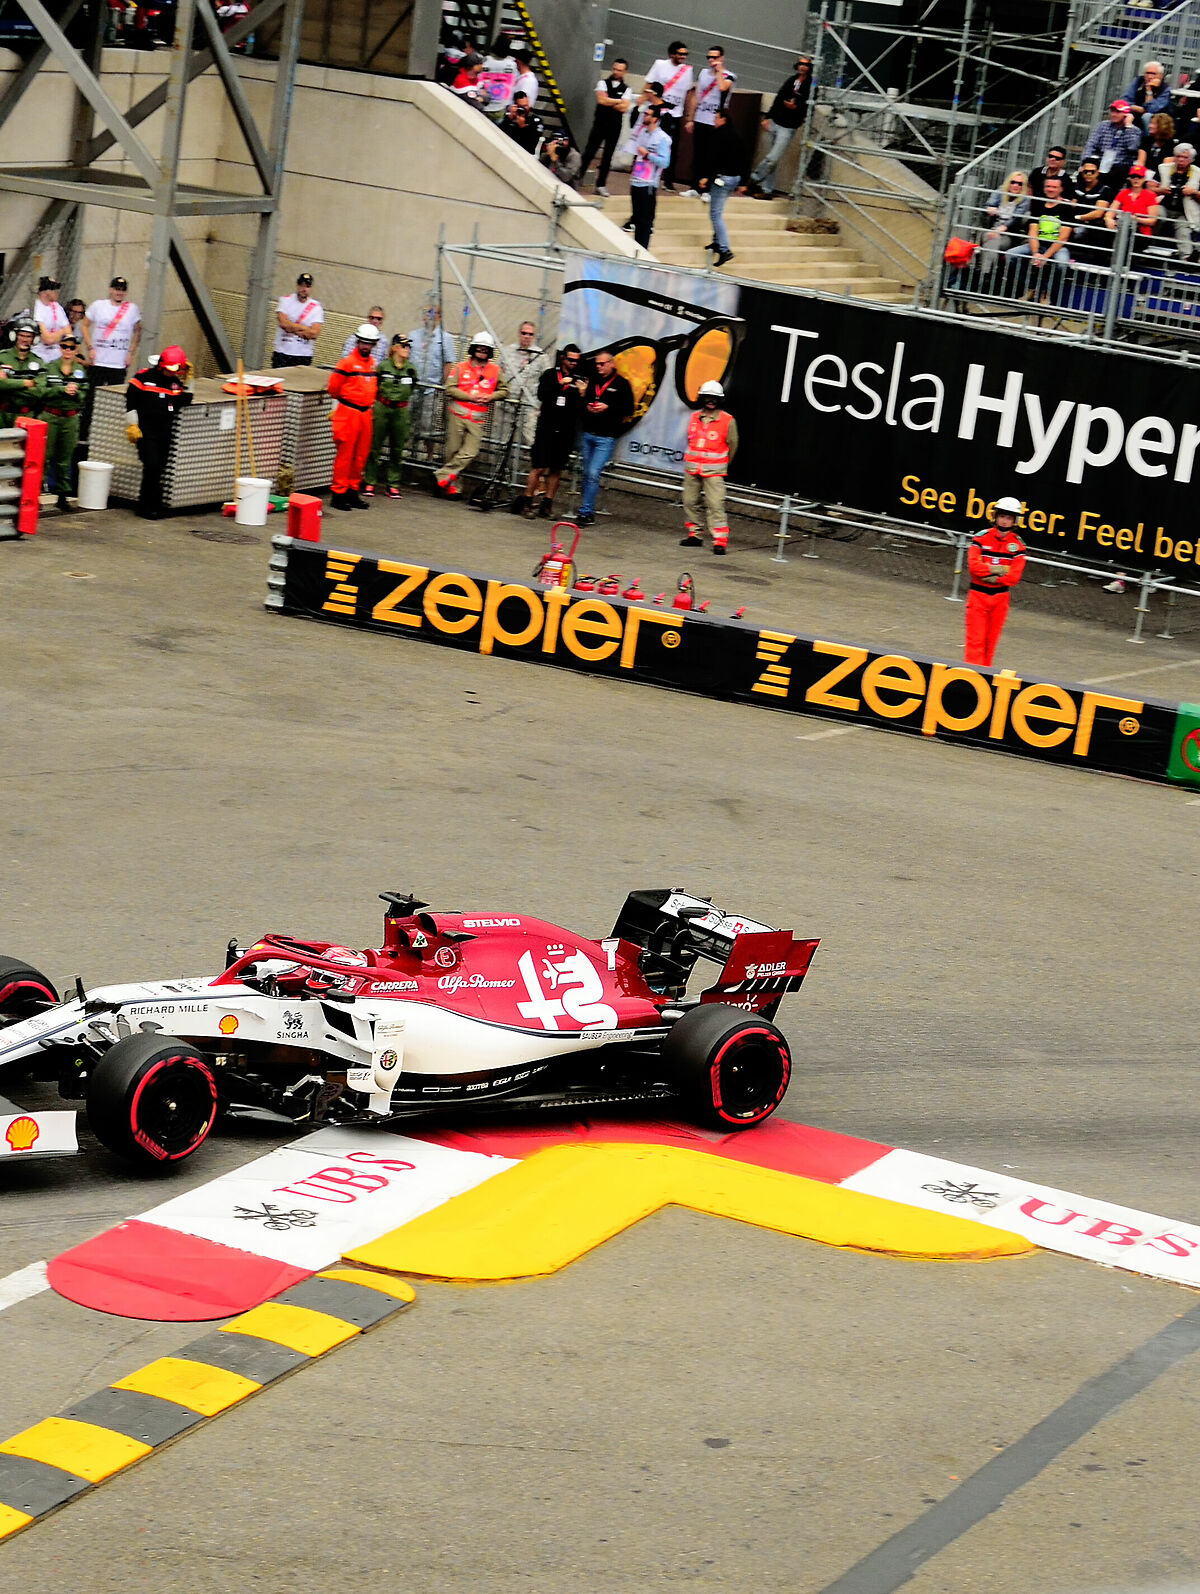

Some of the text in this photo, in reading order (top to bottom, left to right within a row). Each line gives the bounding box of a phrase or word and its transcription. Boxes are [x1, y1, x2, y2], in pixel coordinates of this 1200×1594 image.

[770, 325, 1200, 484] Tesla Hyper
[900, 475, 957, 513] See
[966, 488, 1066, 537] beter.
[1077, 511, 1145, 553] Feel
[372, 559, 684, 668] zepter
[805, 640, 1143, 756] zepter
[463, 918, 521, 928] STELVIO
[438, 974, 516, 995] Alfa Romeo
[757, 961, 787, 972] ADLER
[370, 980, 419, 991] CARRERA
[130, 1004, 209, 1015] RICHARD MILLE
[276, 1031, 309, 1039] SINGHA
[272, 1151, 416, 1203] UBS
[1019, 1195, 1199, 1257] UBS
